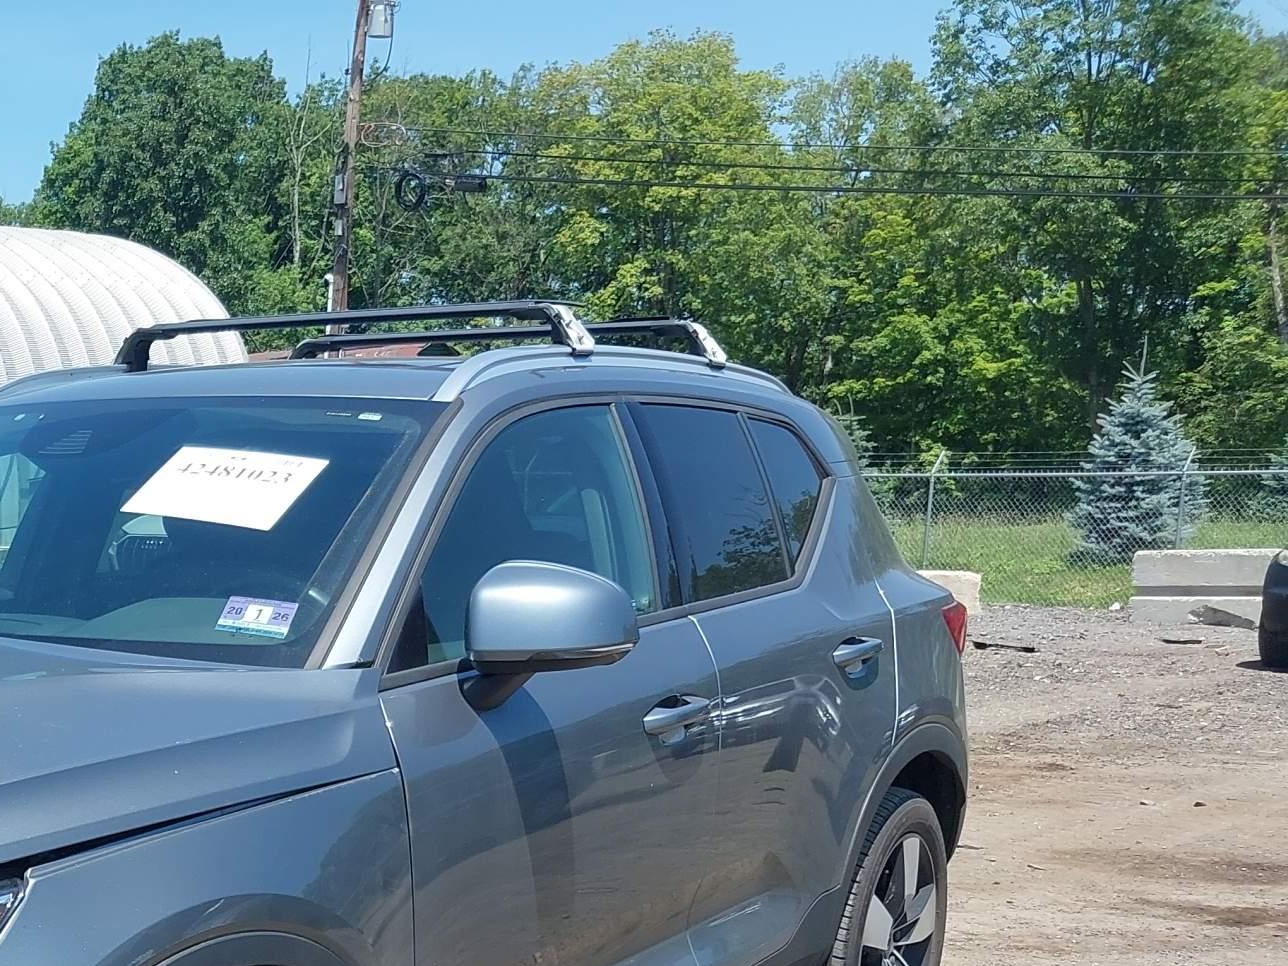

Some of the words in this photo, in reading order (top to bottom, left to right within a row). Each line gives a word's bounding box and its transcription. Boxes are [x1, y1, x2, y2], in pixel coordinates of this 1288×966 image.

[177, 462, 293, 484] 42481023
[226, 606, 243, 616] 20
[254, 608, 264, 622] 1
[271, 612, 290, 622] 26
